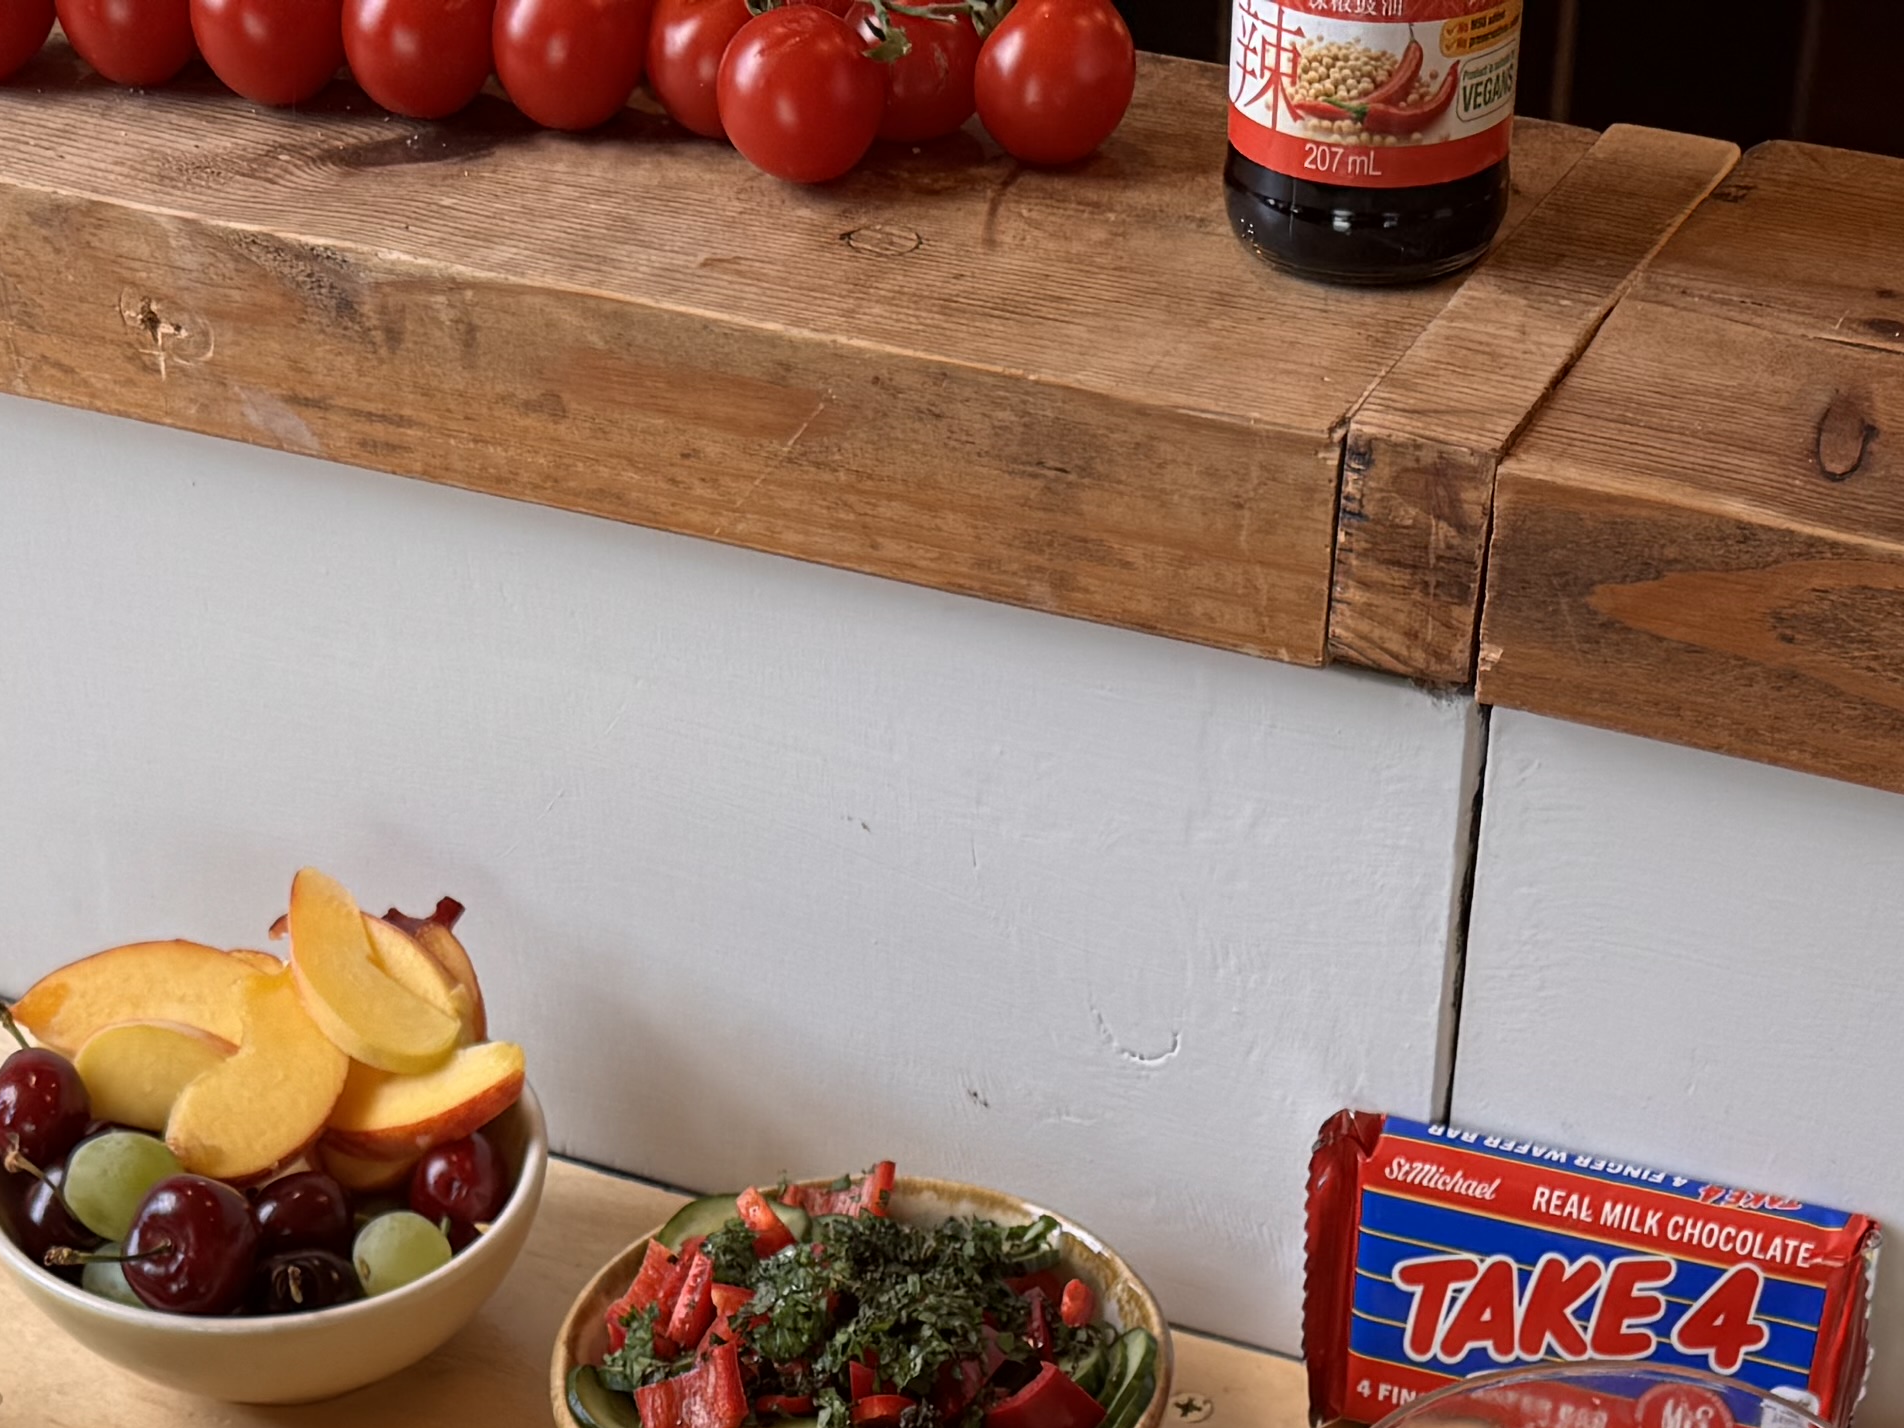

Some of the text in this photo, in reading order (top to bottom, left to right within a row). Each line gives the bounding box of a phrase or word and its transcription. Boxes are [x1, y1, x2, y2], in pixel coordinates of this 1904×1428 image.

[1463, 64, 1514, 113] VEGANS
[1304, 143, 1344, 171] 207
[1532, 1185, 1817, 1269] REAL MILK CHOCOLATE
[1393, 1251, 1771, 1375] TAKE 4
[1356, 1379, 1372, 1398] 4
